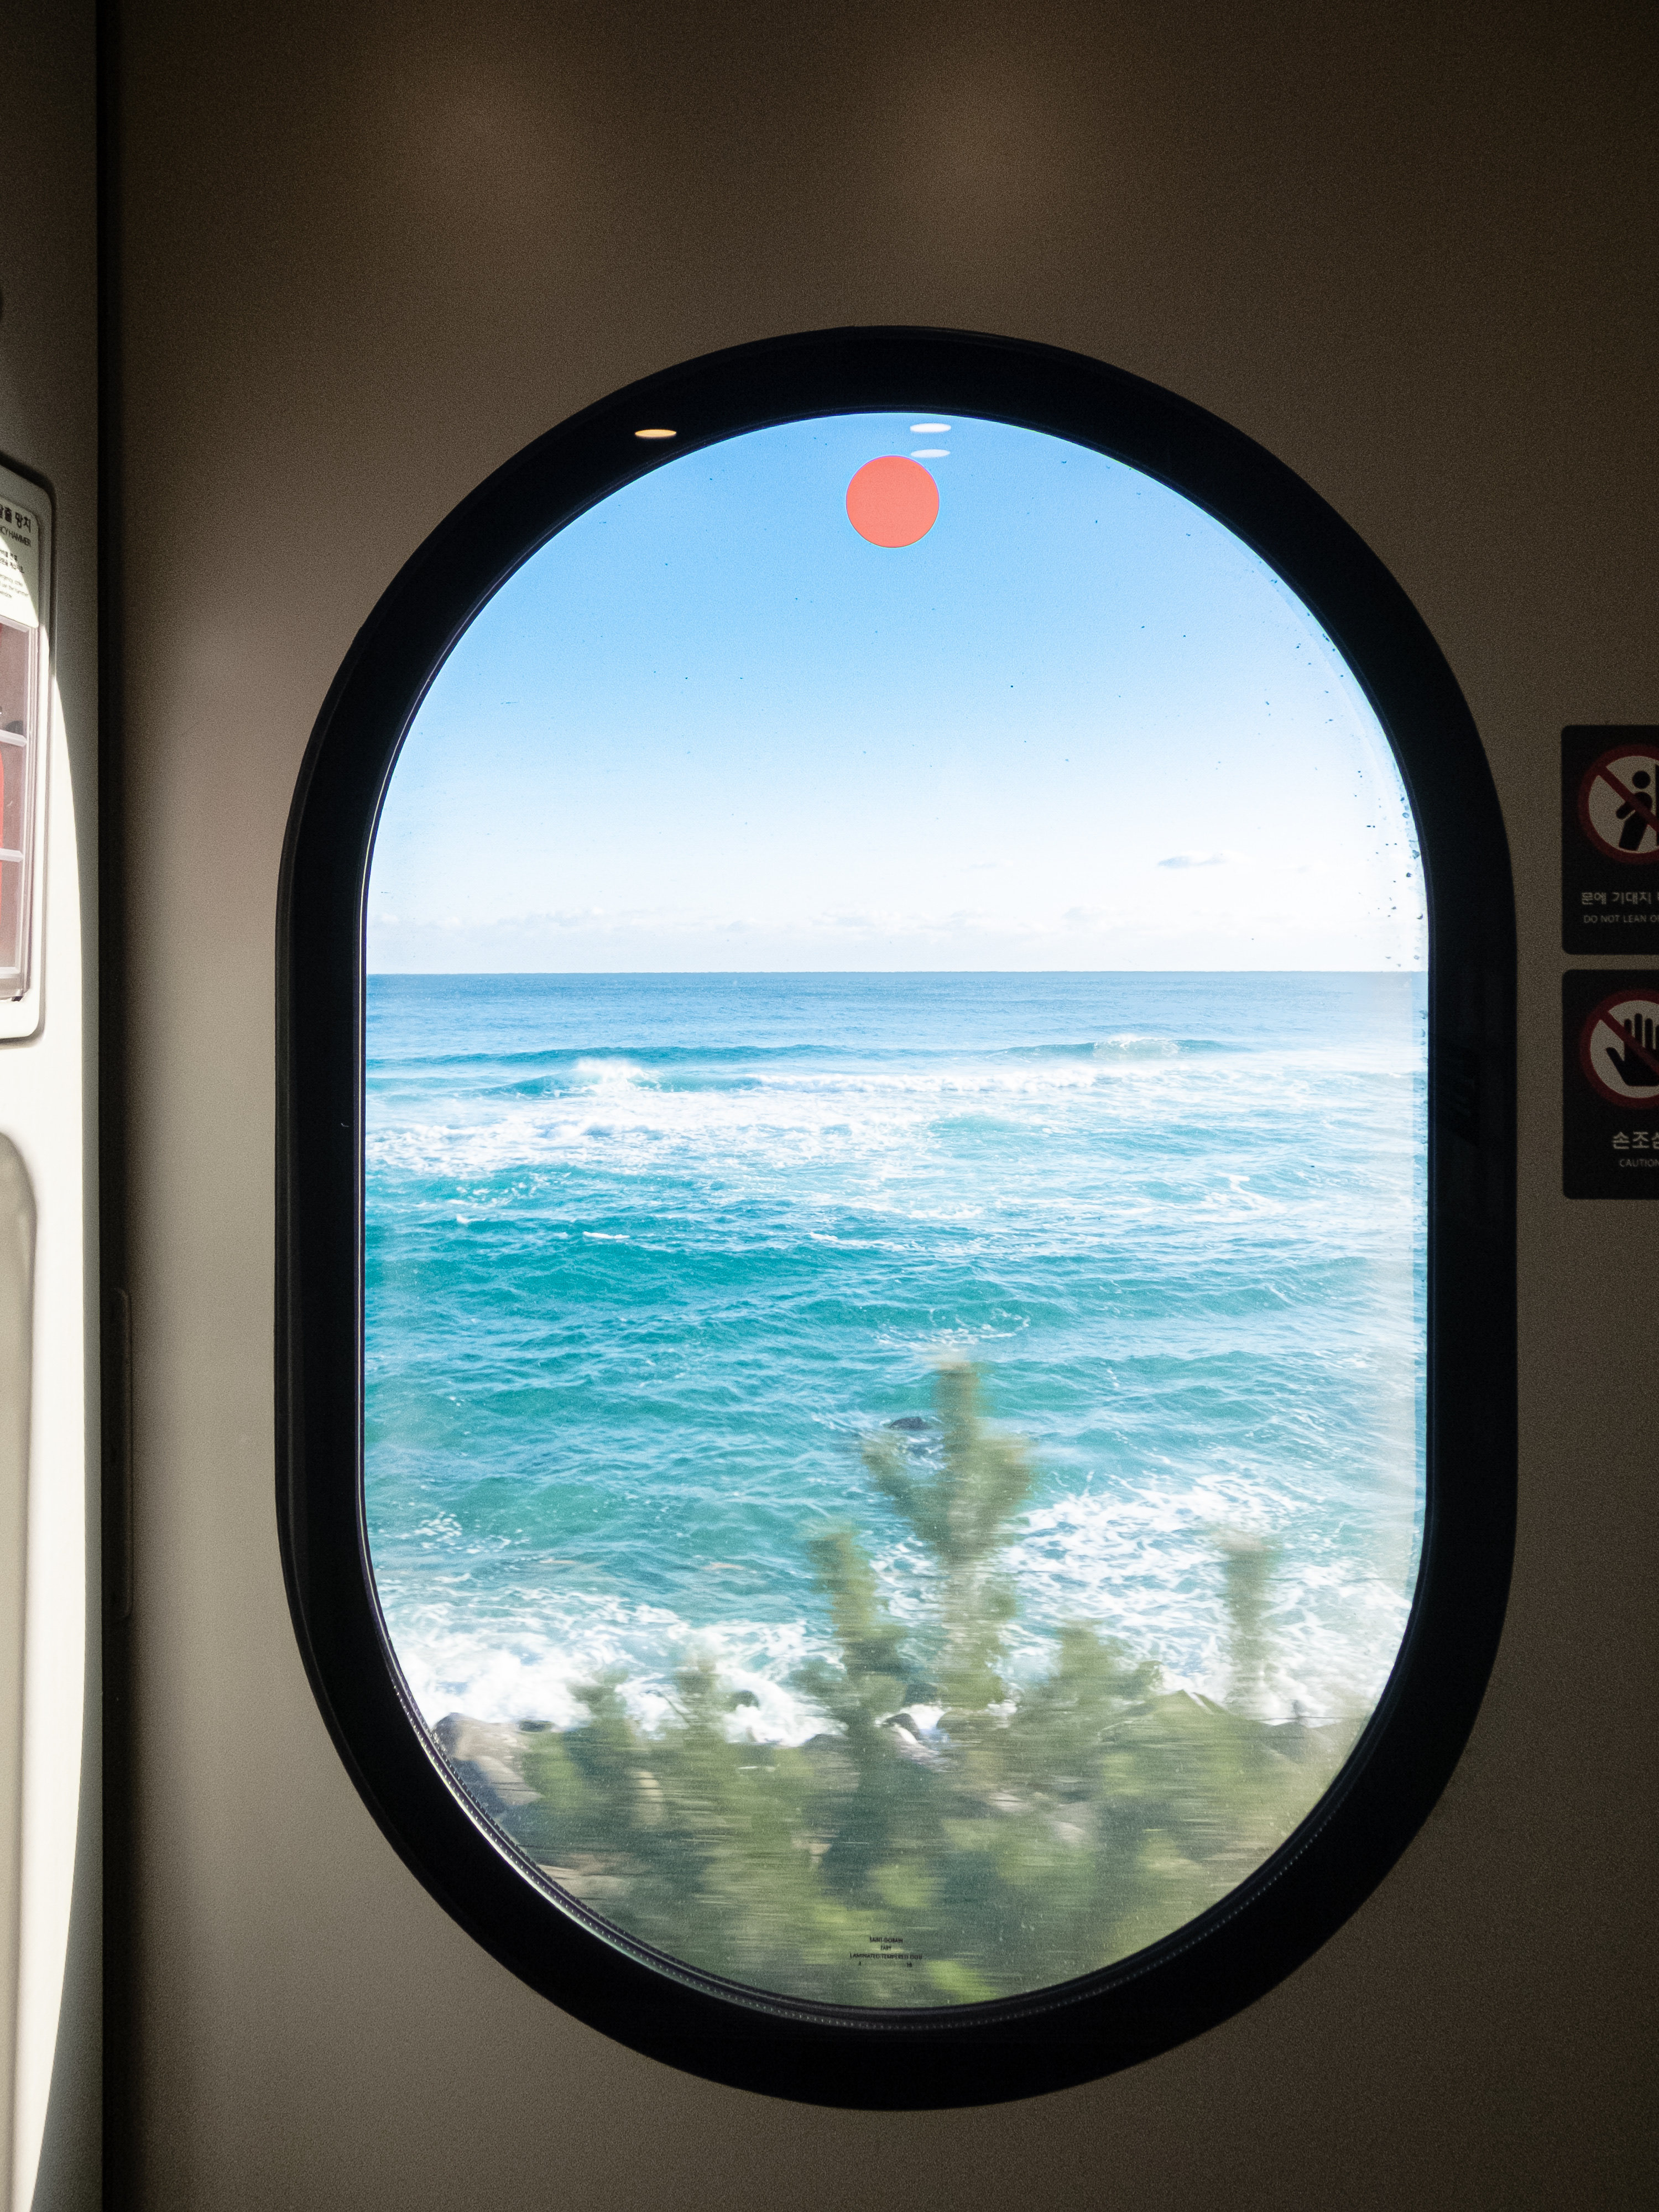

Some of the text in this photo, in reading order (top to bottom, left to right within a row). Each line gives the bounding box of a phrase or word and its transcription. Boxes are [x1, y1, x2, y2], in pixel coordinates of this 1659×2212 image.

[1581, 891, 1607, 905] 문에
[1611, 891, 1652, 905] 기대지
[1583, 915, 1598, 924] DO
[1600, 915, 1620, 923] NOT
[1623, 915, 1647, 923] LEAN
